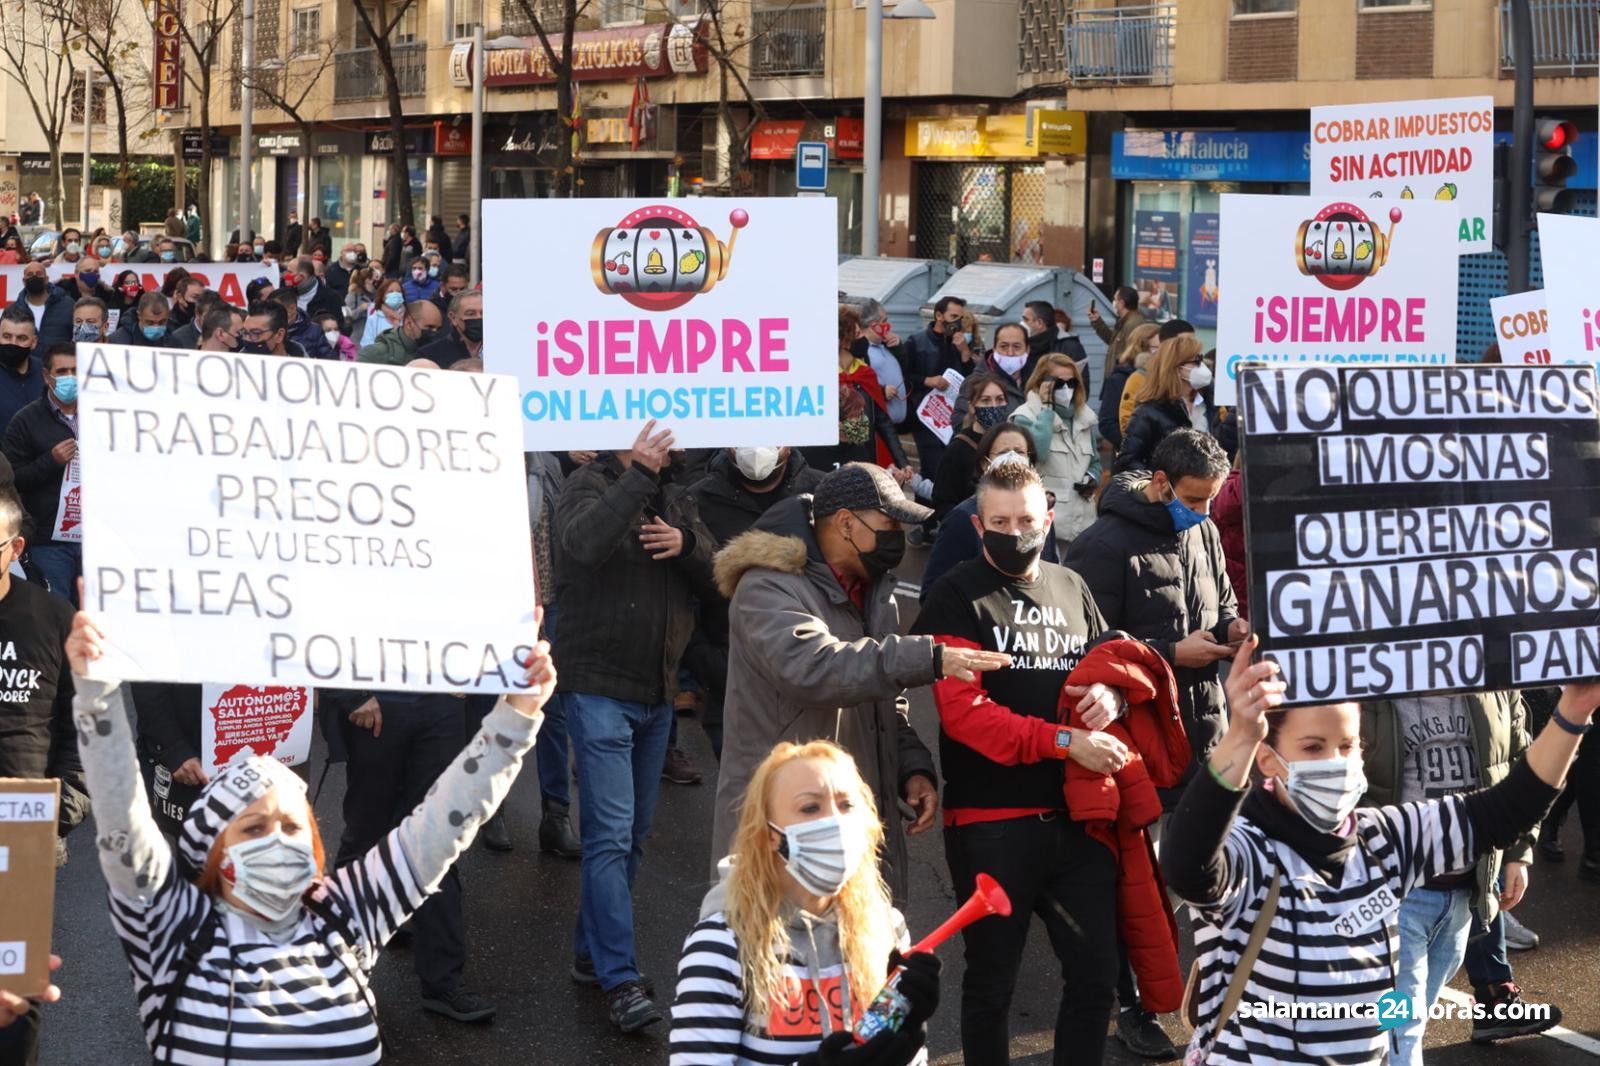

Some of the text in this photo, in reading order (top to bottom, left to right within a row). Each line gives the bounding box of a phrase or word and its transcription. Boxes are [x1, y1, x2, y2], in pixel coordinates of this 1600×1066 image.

[489, 47, 528, 77] HOTEL
[1162, 137, 1249, 160] santalucía
[1314, 110, 1492, 144] COBRAR IMPUESTOS
[1329, 146, 1472, 183] SIN ACTIVIDAD
[82, 346, 497, 418] AUTONOMOS Y
[521, 385, 825, 422] ON LA HOSTELERIA!
[1244, 367, 1594, 433] NO QUEREMOS
[94, 407, 501, 474] TRABAJADORES
[1320, 432, 1549, 485] LIMOSNAS
[216, 474, 416, 528] PRESOS
[188, 527, 434, 568] DE VUESTRAS
[1300, 501, 1550, 564] QUEREMOS
[97, 566, 294, 620] PELEAS
[1269, 549, 1598, 636] GANARNOS
[269, 632, 534, 689] POLITICAS
[1263, 628, 1600, 701] NUESTRO PAN
[218, 691, 301, 708] AUTÓNOM@S
[218, 702, 301, 719] SALAMANCA
[1414, 745, 1476, 782] 1991
